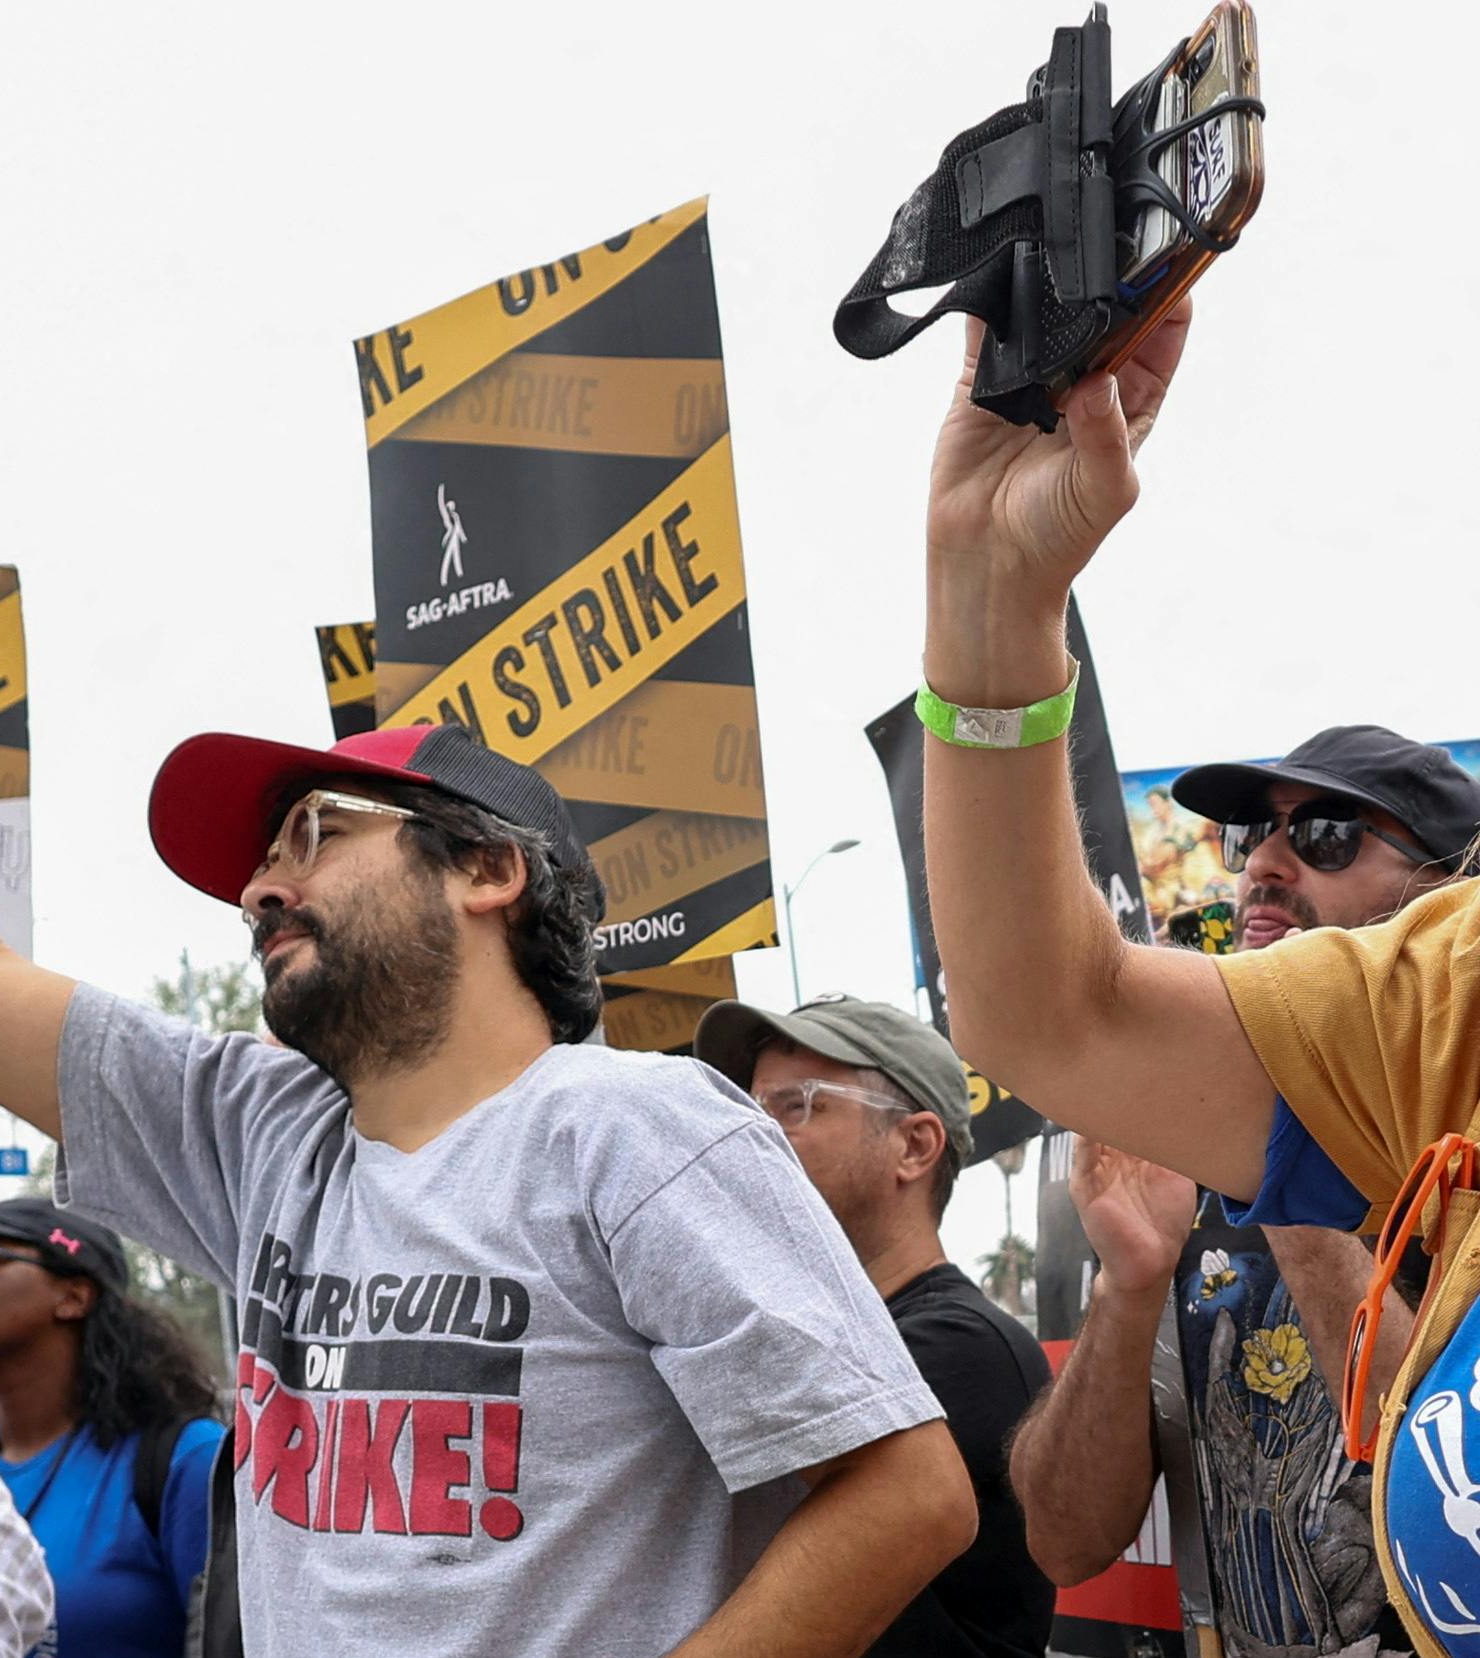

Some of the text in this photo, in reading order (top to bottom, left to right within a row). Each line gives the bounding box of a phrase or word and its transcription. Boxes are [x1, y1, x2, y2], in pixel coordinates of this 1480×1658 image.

[493, 501, 719, 739] STRIKE
[365, 1272, 531, 1343] GUILD
[304, 1343, 347, 1390] ON
